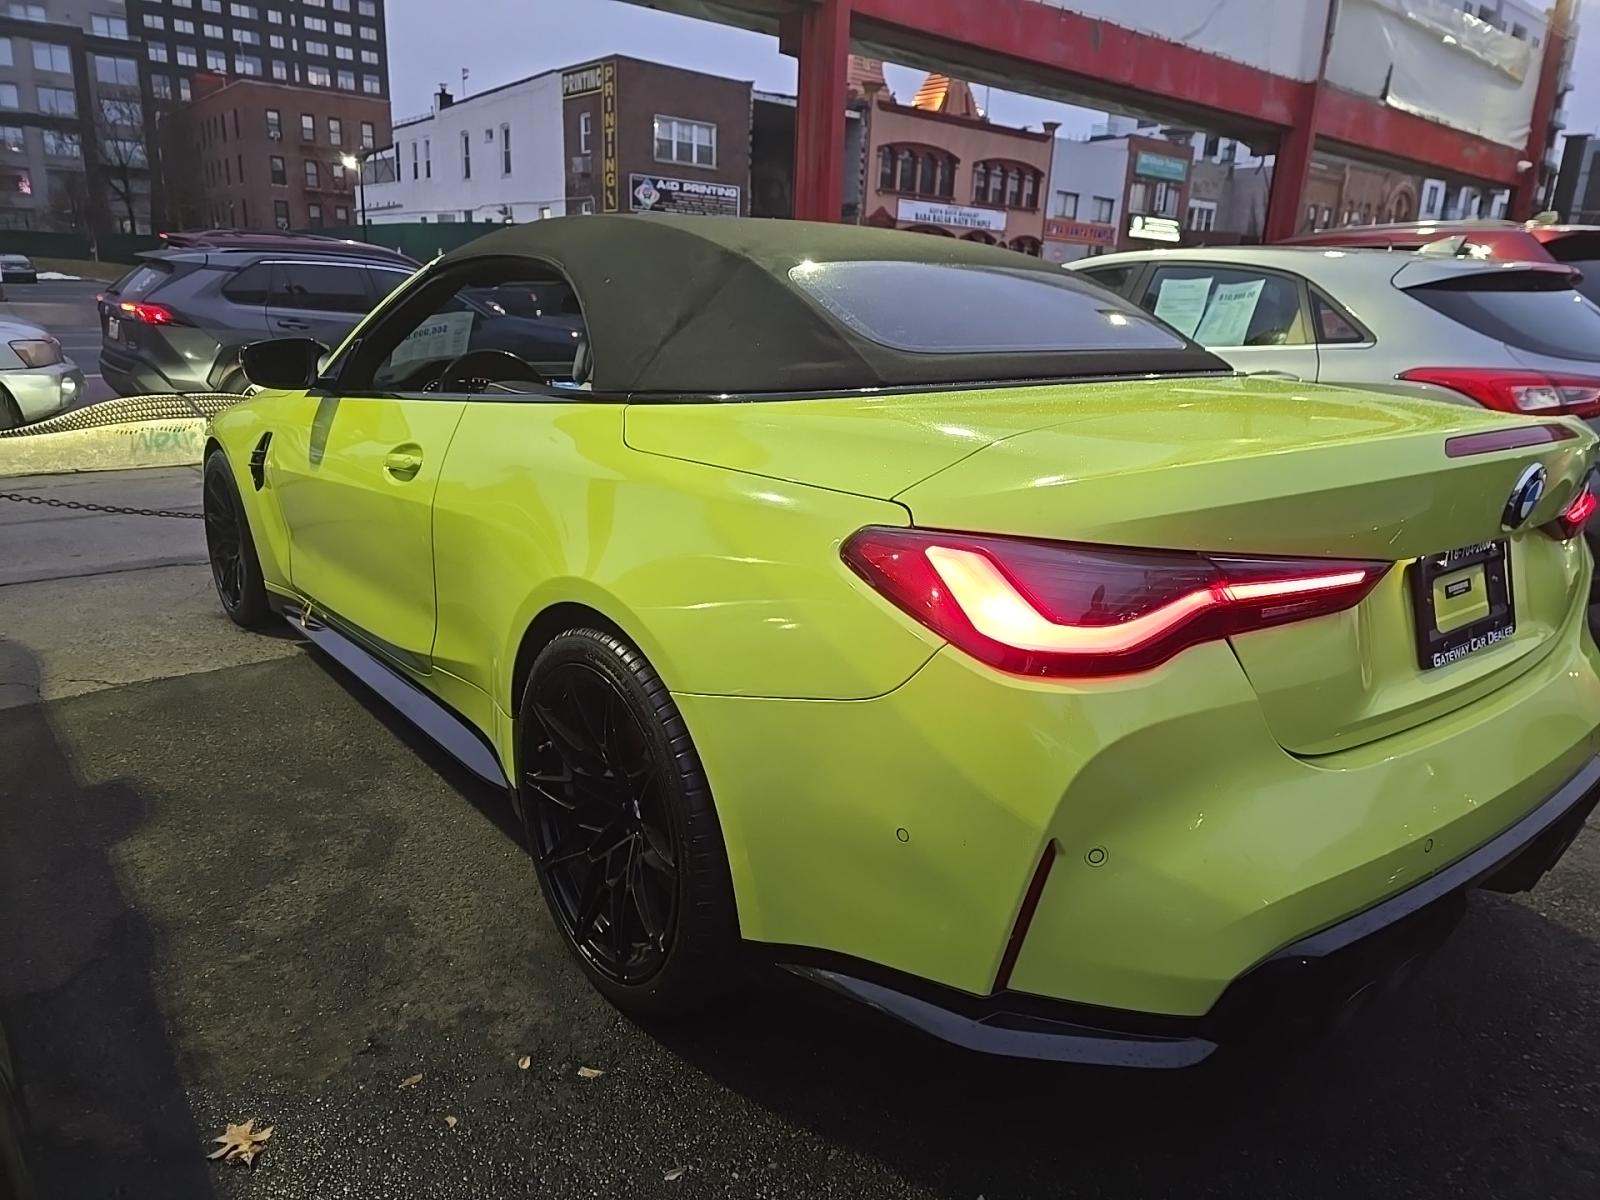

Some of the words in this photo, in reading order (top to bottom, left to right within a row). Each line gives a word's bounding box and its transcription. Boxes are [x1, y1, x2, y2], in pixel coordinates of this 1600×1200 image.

[604, 66, 616, 188] PRINTING
[682, 182, 737, 198] PRINTING
[970, 216, 992, 229] TEMPLE
[1433, 642, 1471, 668] GATEWAY
[1470, 637, 1487, 652] CAR
[1487, 625, 1514, 645] DEALER
